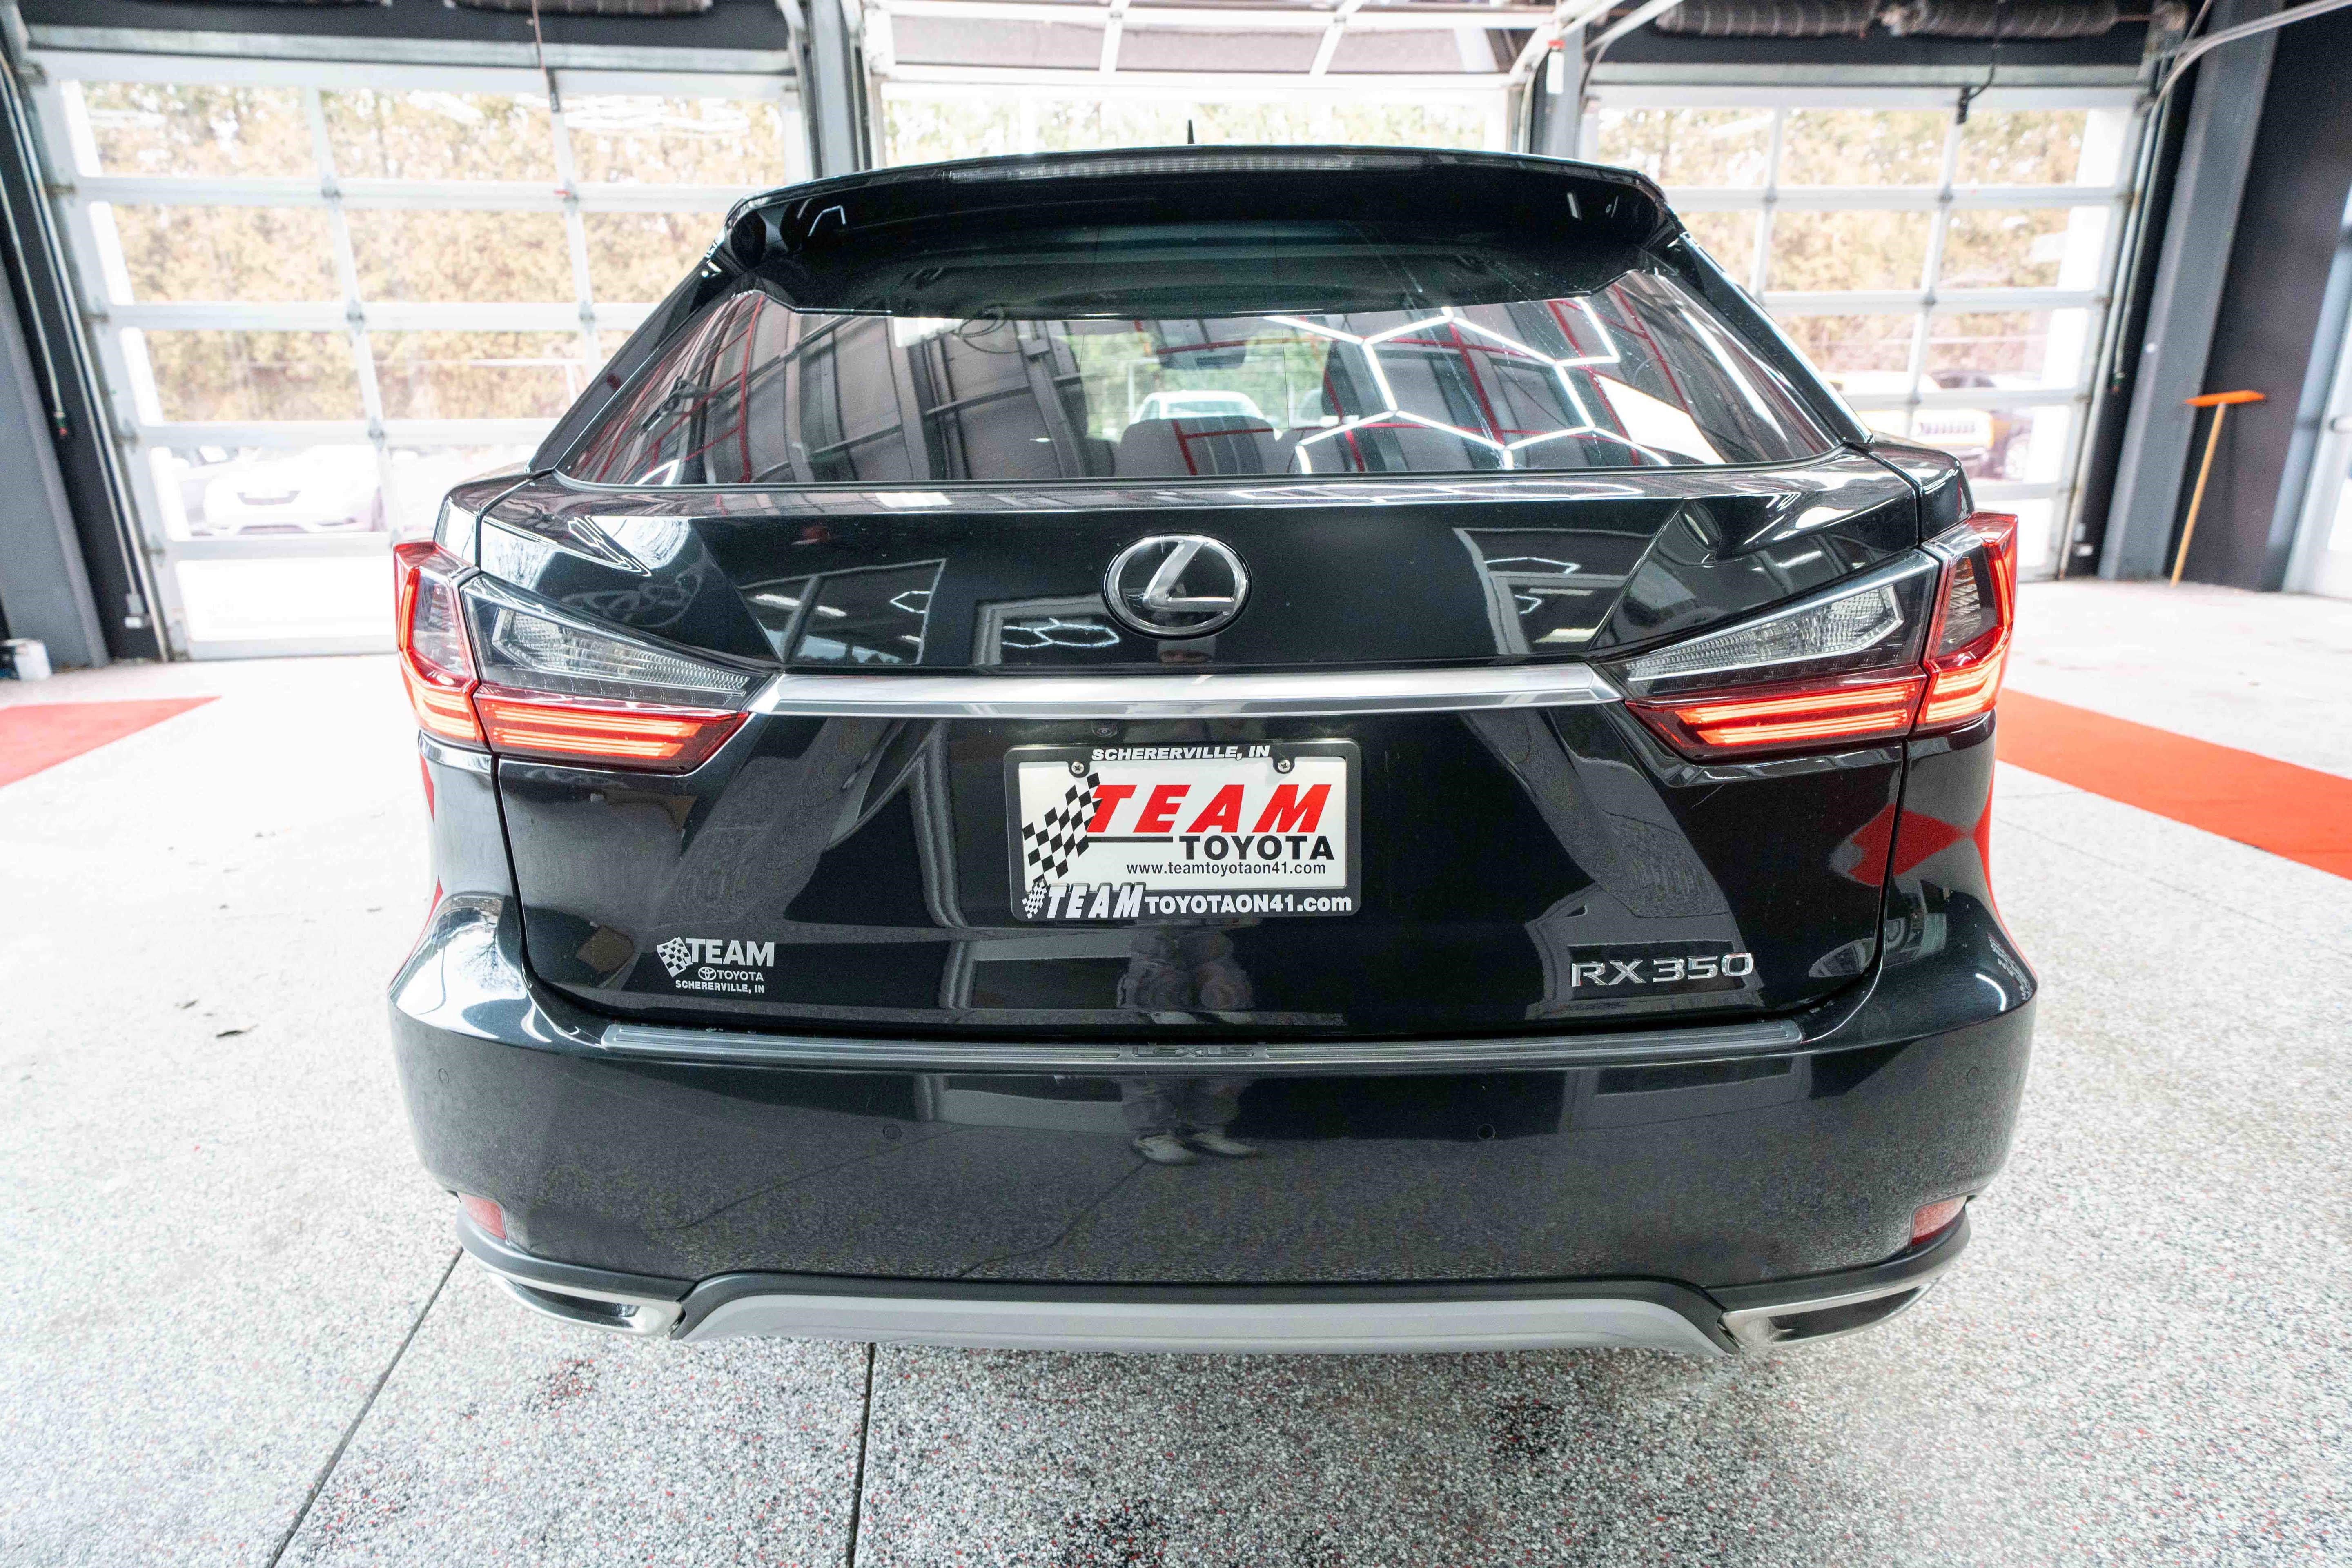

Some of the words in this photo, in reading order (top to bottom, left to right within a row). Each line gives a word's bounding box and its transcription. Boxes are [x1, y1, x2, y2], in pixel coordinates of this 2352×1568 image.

[1092, 746, 1242, 760] SCHERERVILLE,
[1249, 745, 1270, 757] IN
[1087, 784, 1332, 833] TEAM
[1179, 835, 1334, 860] TOYOTA
[1127, 862, 1326, 877] www.teamtoyotaon41.com
[1047, 885, 1143, 918] TEAM
[1145, 894, 1352, 914] TOYOTAON41.com
[686, 938, 775, 967] TEAM
[717, 970, 764, 981] TOYOTA
[675, 980, 751, 993] SCHERERVILLE,
[755, 985, 765, 993] IN
